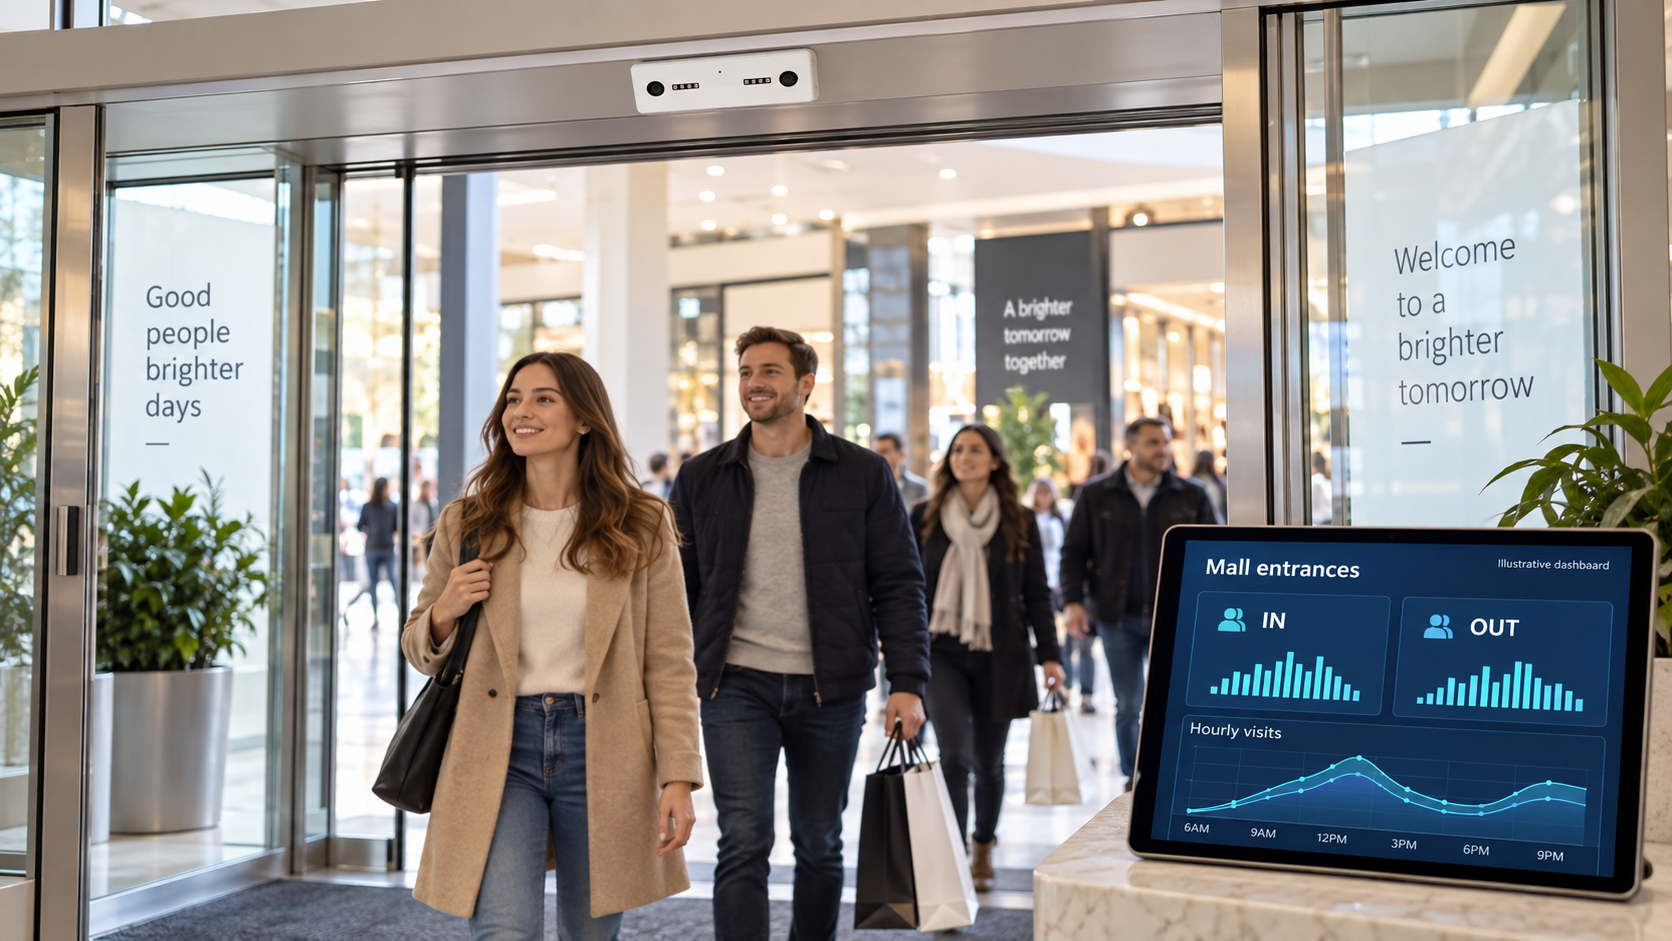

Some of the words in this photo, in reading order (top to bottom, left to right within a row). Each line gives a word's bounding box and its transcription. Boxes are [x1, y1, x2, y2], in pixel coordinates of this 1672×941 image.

[1394, 238, 1516, 275] Welcome
[146, 282, 211, 309] Good
[1396, 292, 1422, 318] to
[1432, 292, 1446, 314] a
[1003, 300, 1016, 318] A
[1018, 297, 1073, 321] brighter
[146, 318, 230, 351] people
[1004, 328, 1071, 344] tomorrow
[1398, 326, 1504, 366] brighter
[146, 355, 244, 387] brighter
[1004, 351, 1066, 375] together
[1398, 375, 1535, 406] tomorrow
[145, 392, 202, 424] days
[1205, 557, 1251, 576] Mall
[1256, 560, 1360, 579] entrances
[1497, 558, 1552, 570] Illustrative
[1262, 611, 1286, 630] IN
[1470, 617, 1520, 637] OUT
[1190, 722, 1240, 740] Hourly
[1243, 725, 1282, 740] visits
[1183, 822, 1210, 834] 6AM
[1250, 827, 1277, 839] 9AM
[1317, 832, 1348, 845] 12PM
[1391, 838, 1417, 850] 3PM
[1463, 844, 1490, 856] 6PM
[1536, 850, 1564, 862] 9PM
